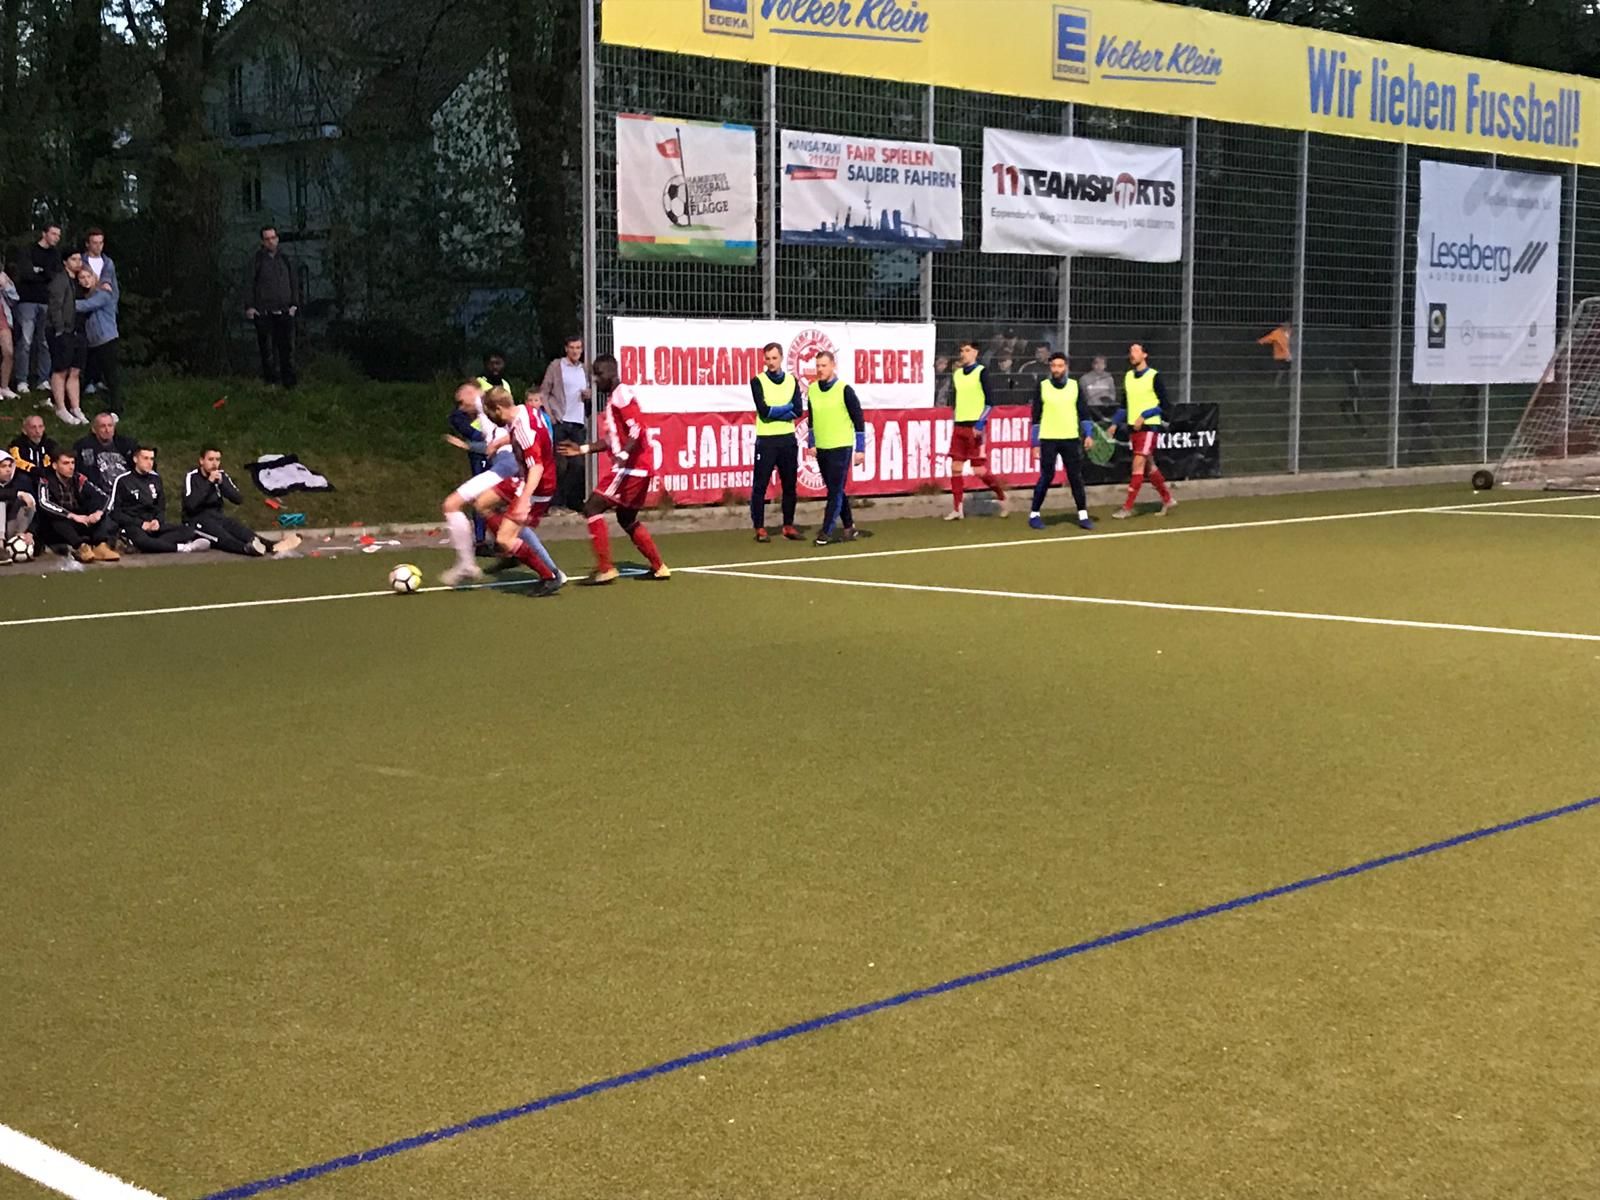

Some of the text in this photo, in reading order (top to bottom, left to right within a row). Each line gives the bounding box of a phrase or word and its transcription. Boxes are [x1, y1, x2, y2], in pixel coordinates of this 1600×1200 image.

[709, 15, 749, 29] EDEKA
[761, 0, 850, 27] Volker
[856, 0, 929, 33] Klein
[1095, 35, 1222, 76] Volker Klein
[1057, 63, 1086, 75] EDEKA
[1307, 46, 1580, 148] Wir lieben Fussball!
[847, 144, 934, 166] FAIR SPIELEN
[848, 164, 957, 189] SAUBER FAHREN
[690, 201, 729, 215] FLAGGE
[1430, 232, 1511, 281] Leseberg
[854, 348, 924, 384] BEBEN
[991, 417, 1030, 443] HART
[664, 474, 689, 491] UND
